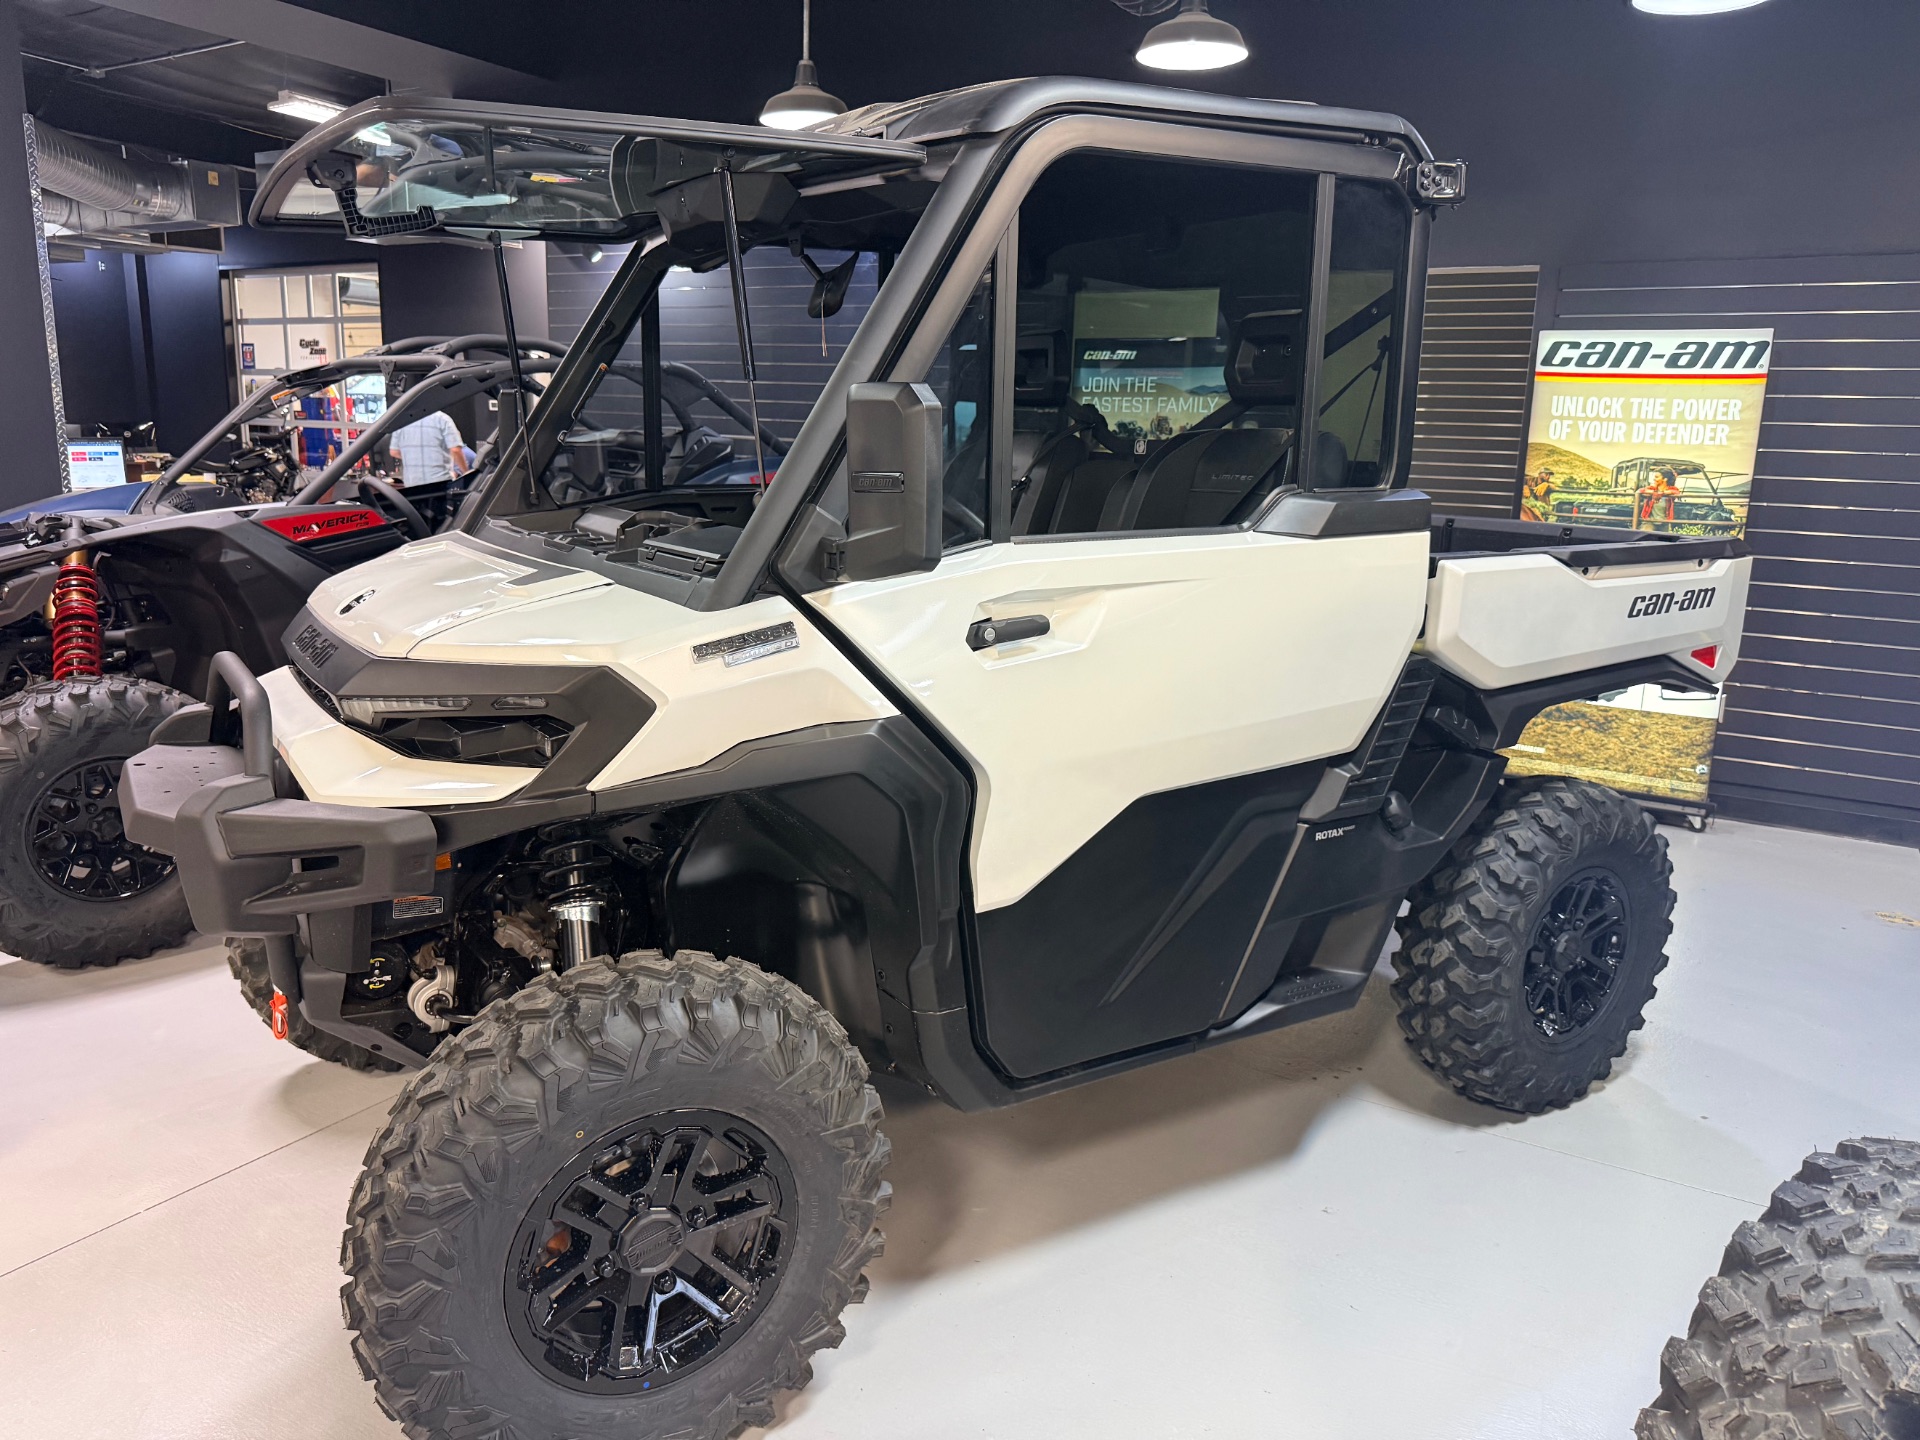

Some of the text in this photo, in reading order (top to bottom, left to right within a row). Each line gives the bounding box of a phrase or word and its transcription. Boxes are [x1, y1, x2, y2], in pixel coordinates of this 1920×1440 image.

[299, 338, 319, 348] Cycle
[1540, 340, 1770, 369] can-am
[1082, 377, 1158, 393] JOIN THE
[1157, 396, 1219, 413] FAMILY
[1551, 395, 1742, 421] UNLOCK THE POWER
[1548, 419, 1730, 446] OF YOUR DEFENDER
[292, 512, 369, 534] MAVERICK
[1627, 587, 1716, 618] can-am
[1315, 828, 1344, 841] ROTAX
